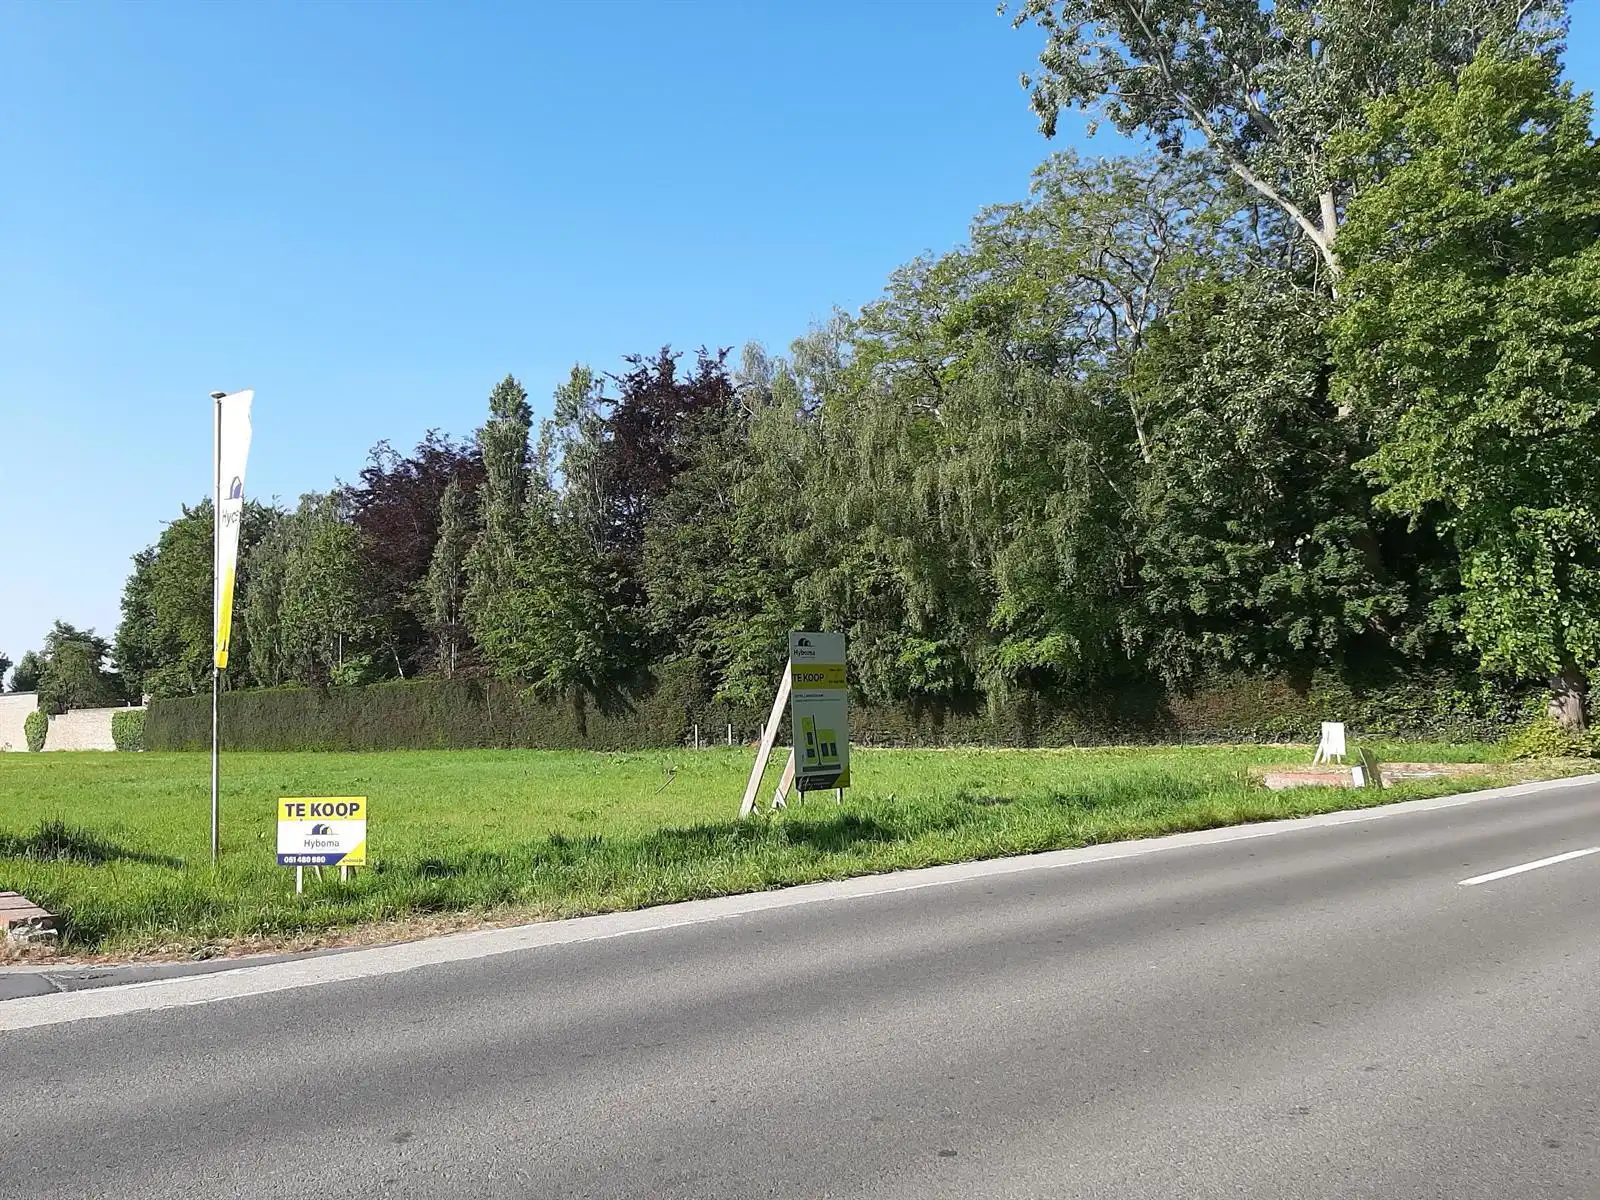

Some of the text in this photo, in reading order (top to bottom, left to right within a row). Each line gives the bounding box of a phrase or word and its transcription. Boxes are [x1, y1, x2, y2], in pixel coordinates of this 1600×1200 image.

[792, 673, 803, 682] TE
[803, 673, 825, 682] KOOP
[285, 802, 360, 817] TE KOOP
[304, 839, 340, 849] Hyboma
